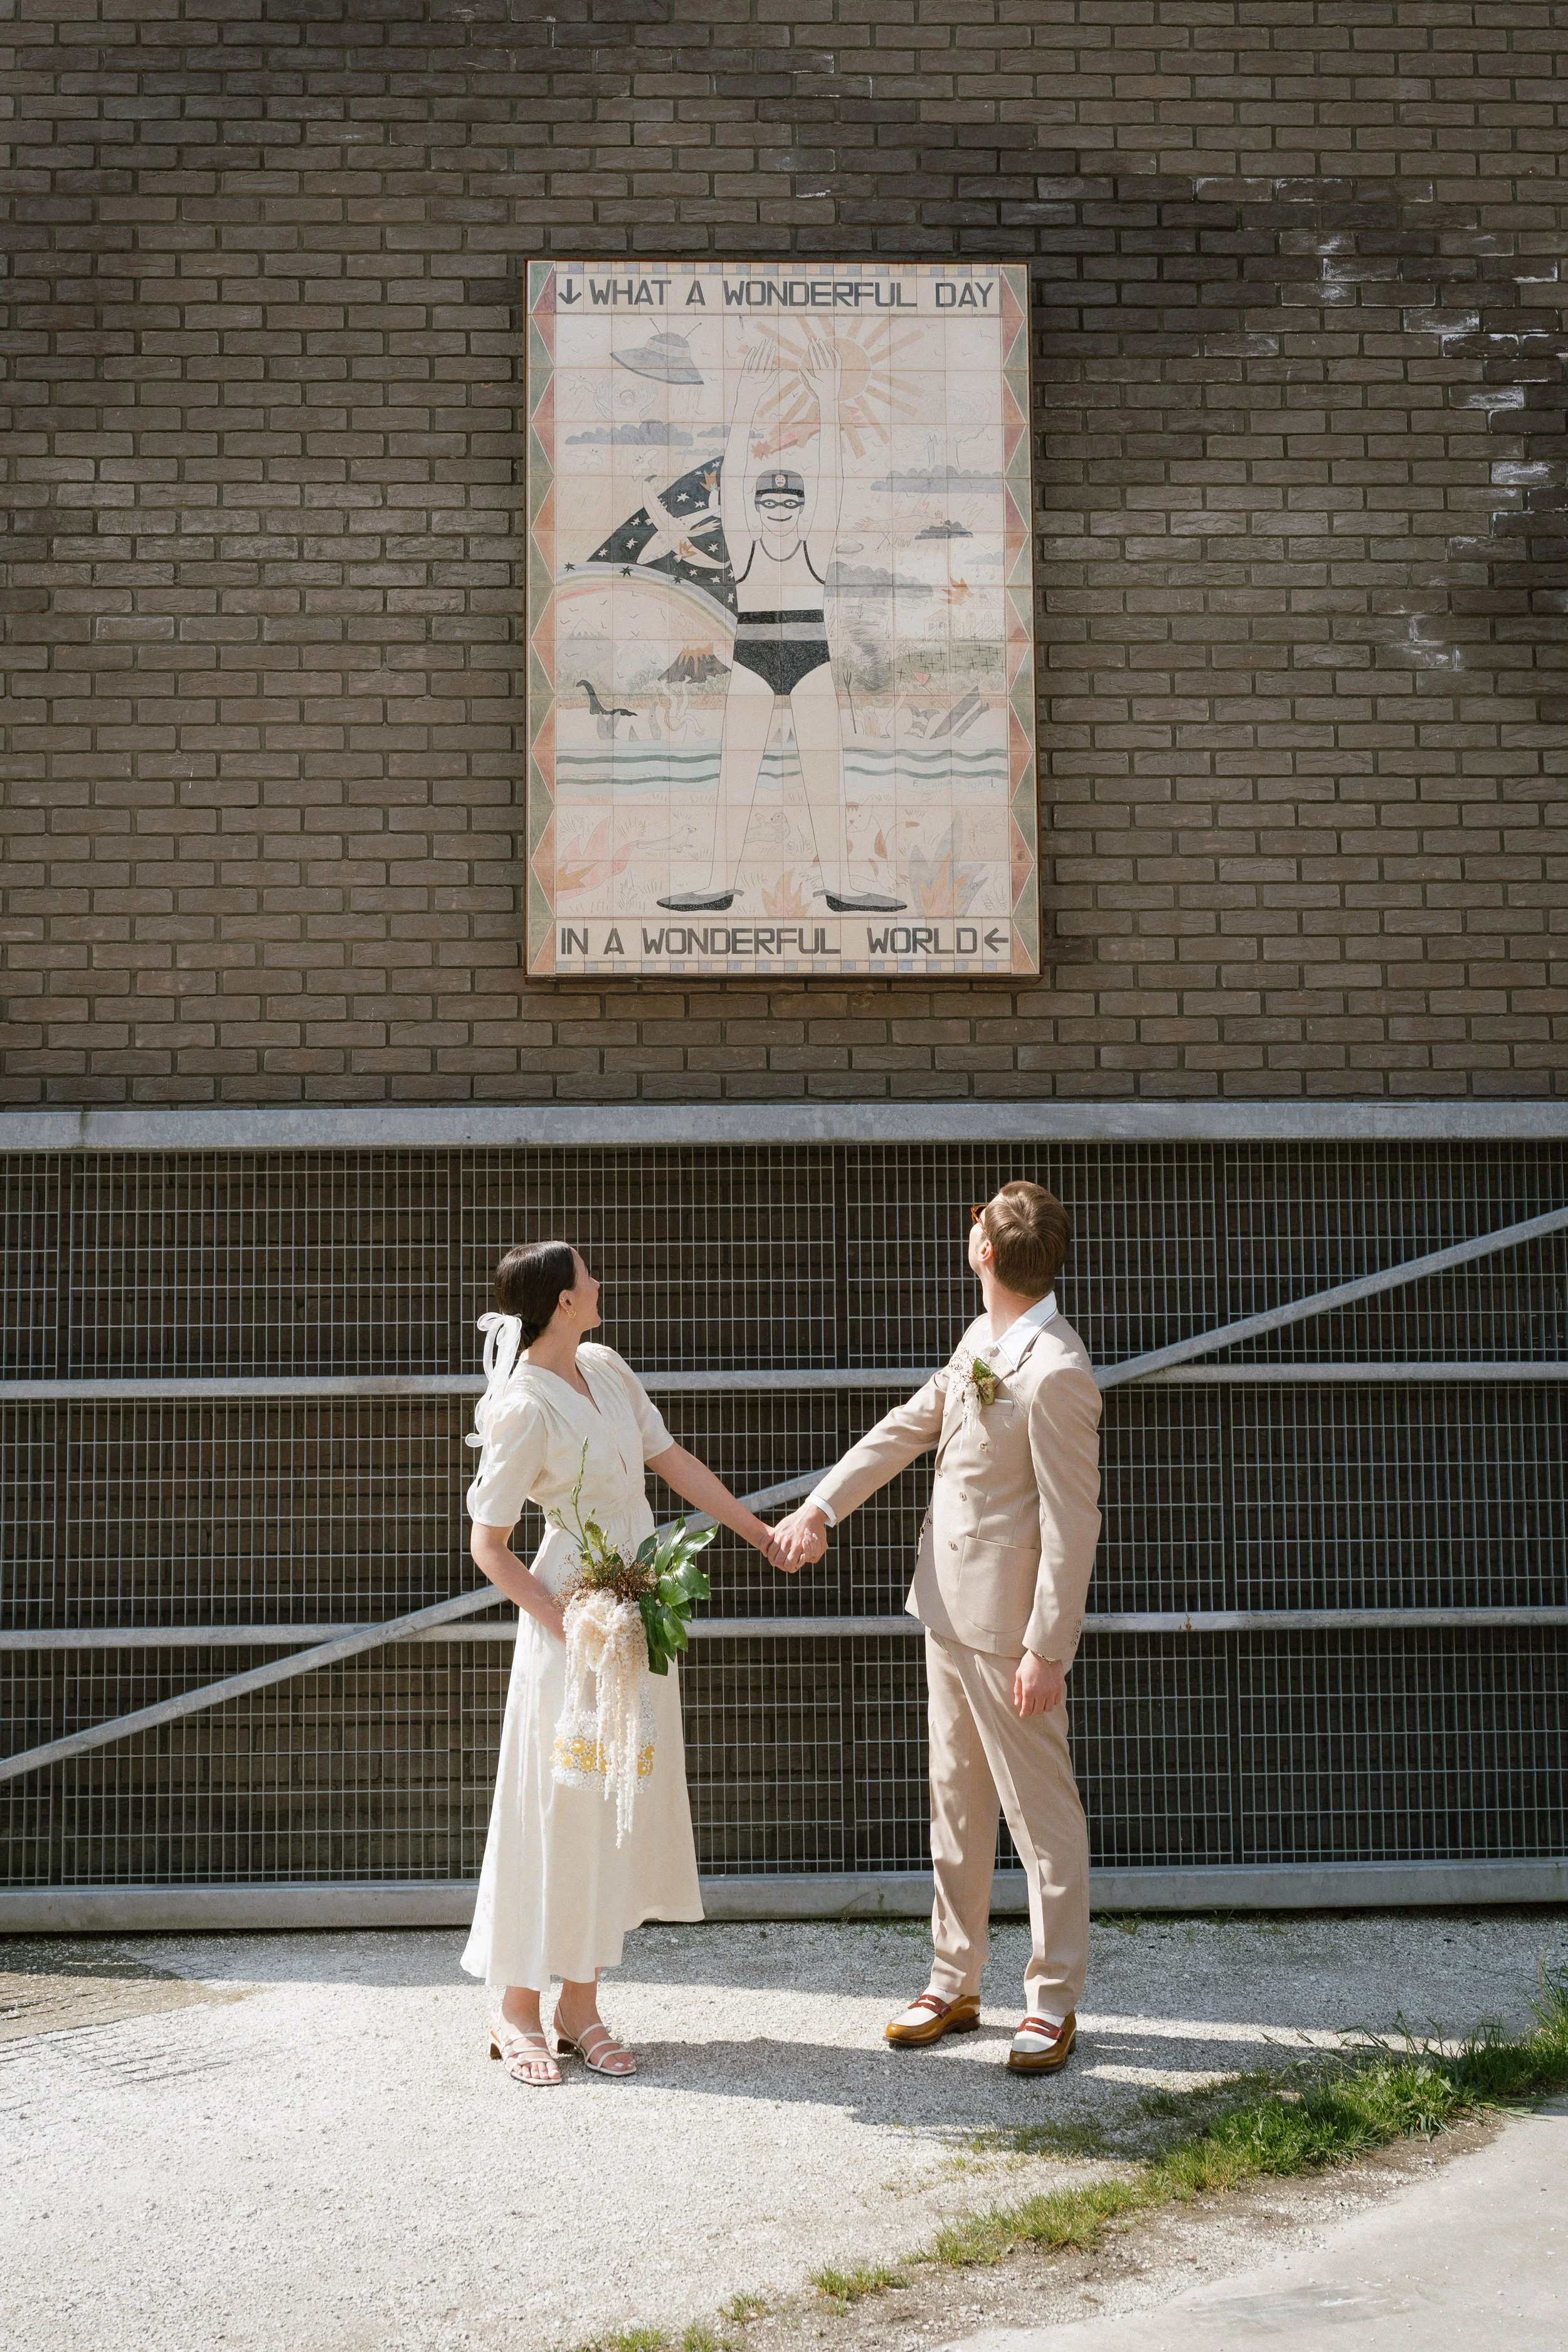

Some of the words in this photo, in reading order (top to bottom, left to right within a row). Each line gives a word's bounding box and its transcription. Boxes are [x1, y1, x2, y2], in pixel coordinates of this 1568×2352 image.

[588, 278, 672, 306] WHAT
[685, 280, 706, 306] A
[723, 280, 918, 307] WONDERFUL
[935, 282, 994, 308] DAY
[561, 927, 589, 955] IN
[603, 927, 625, 955] A
[641, 927, 842, 955] WONDERFUL
[866, 927, 978, 955] WORLD
